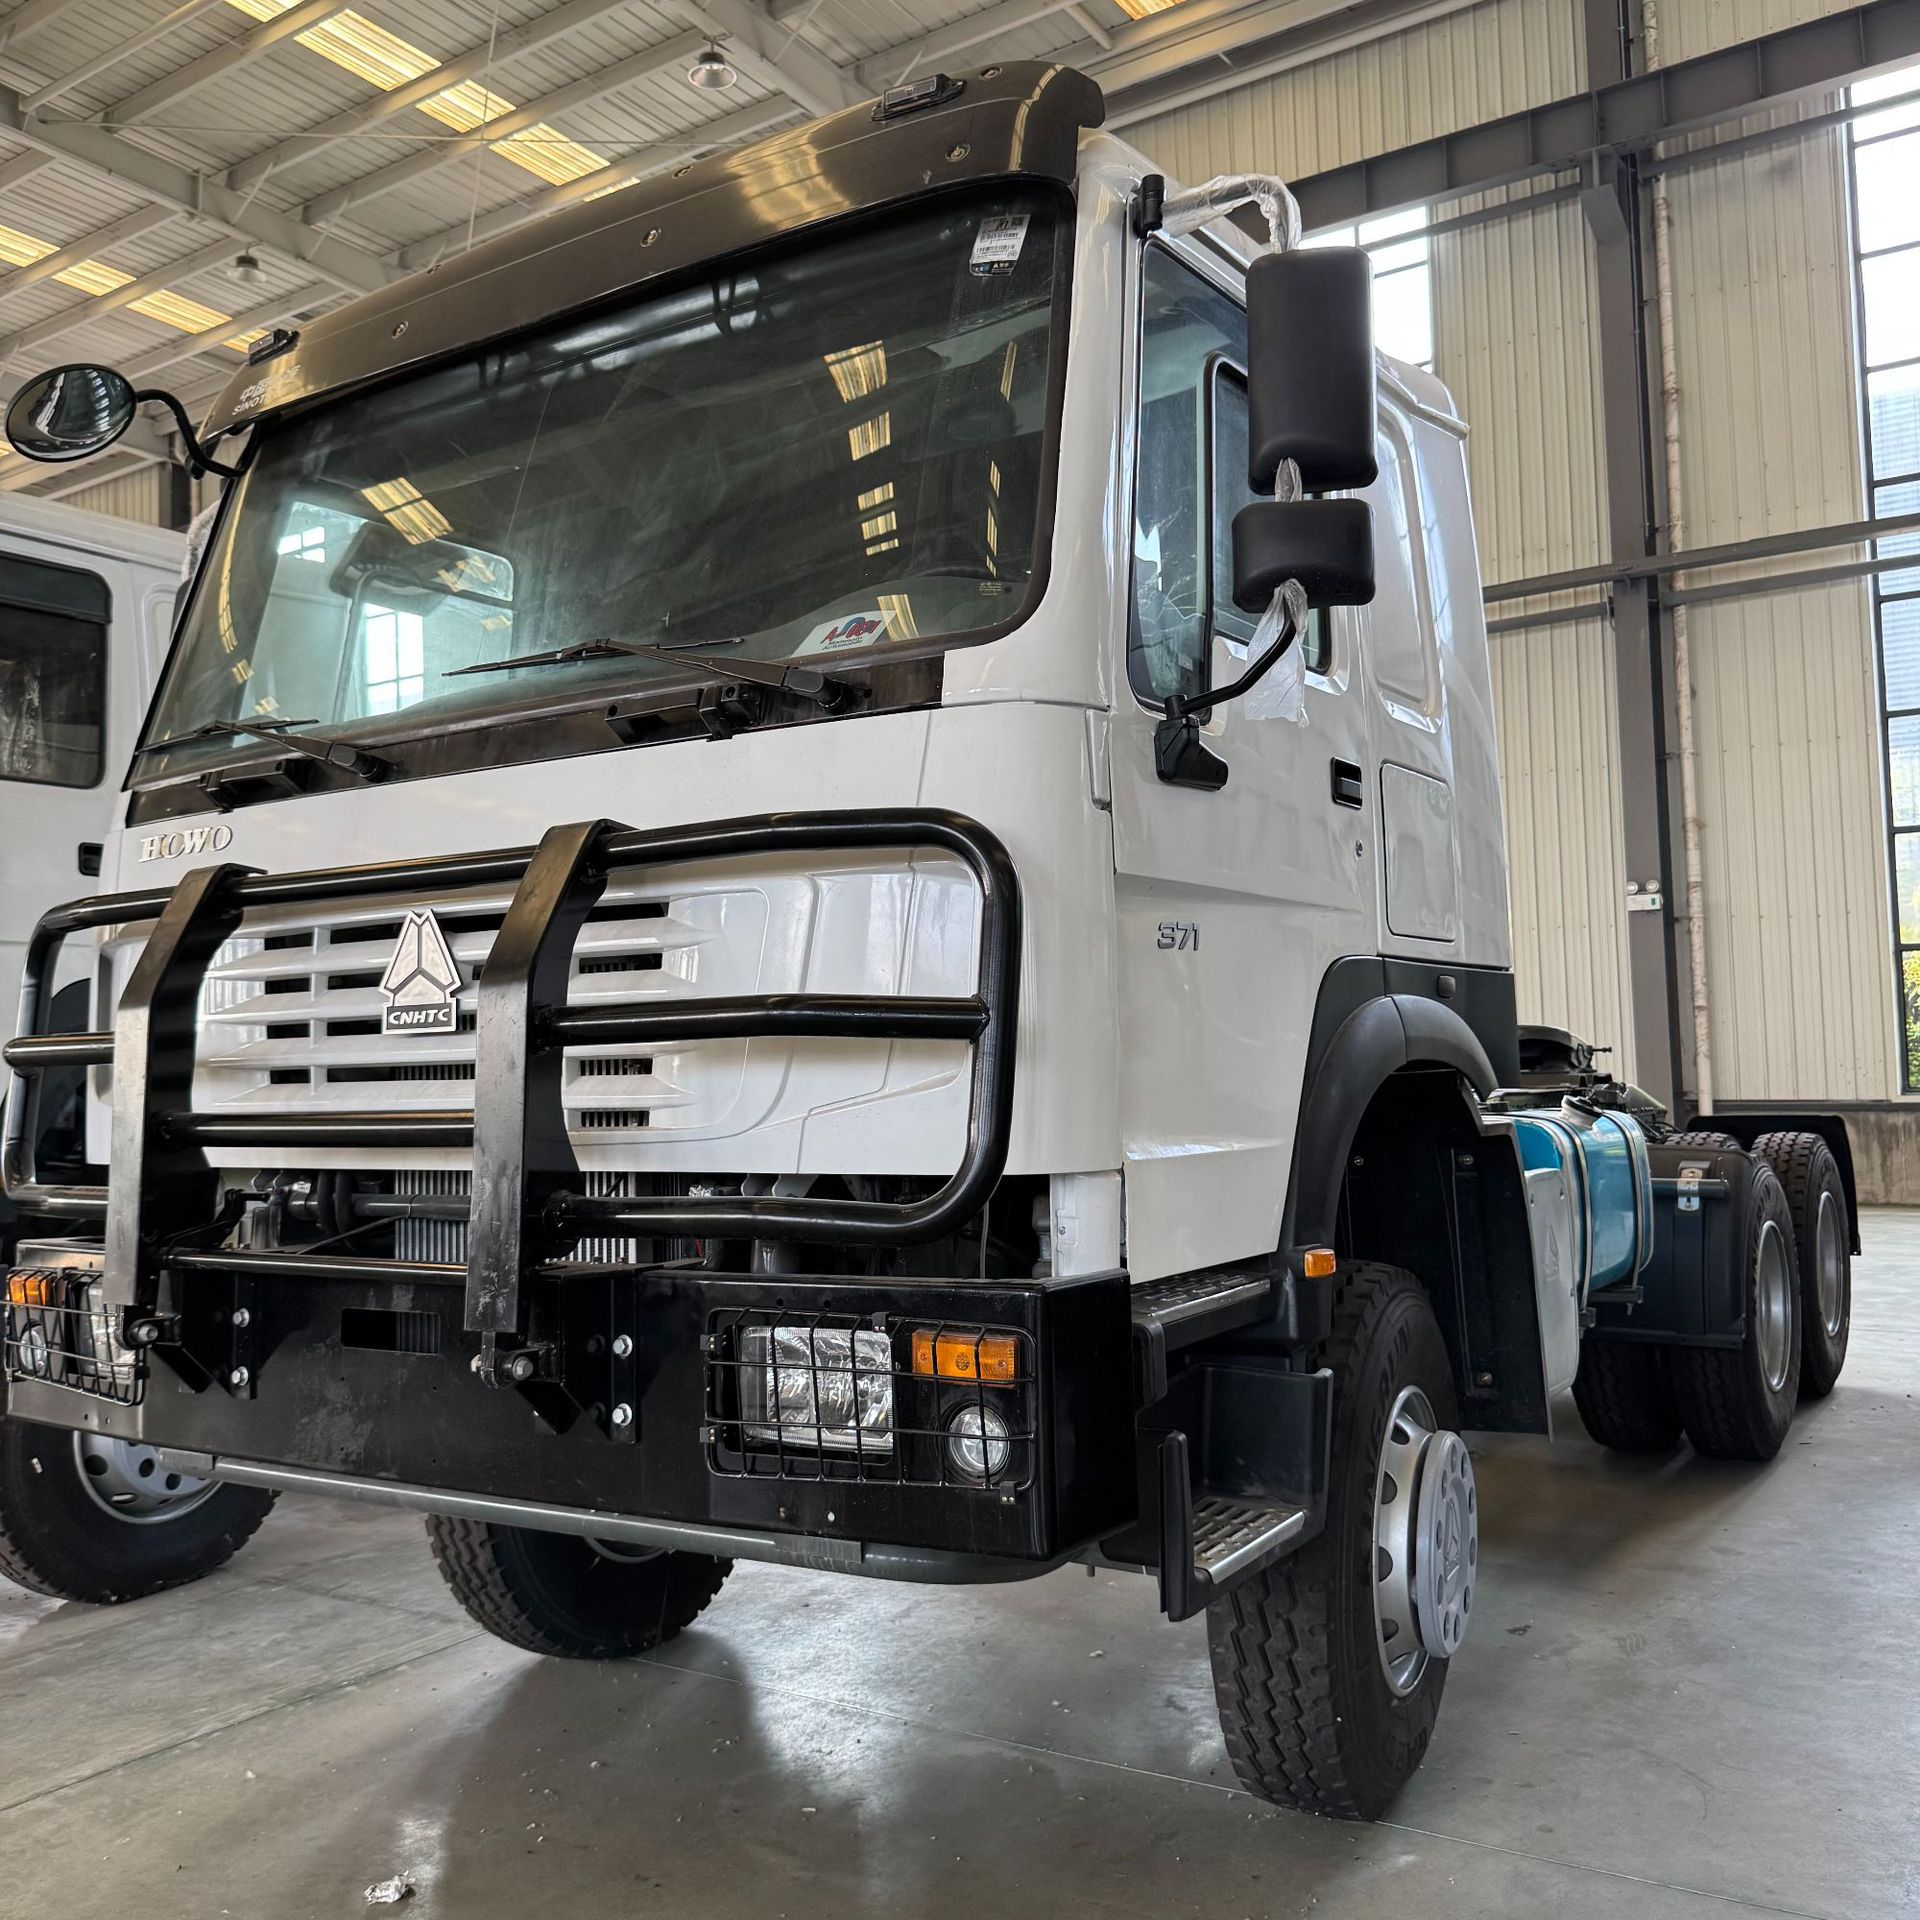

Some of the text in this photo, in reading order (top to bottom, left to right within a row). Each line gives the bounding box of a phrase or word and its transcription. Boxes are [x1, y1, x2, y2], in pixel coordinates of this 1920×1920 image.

[138, 825, 233, 863] HOWO
[1157, 921, 1200, 951] 371
[389, 1008, 450, 1025] CNHTC
